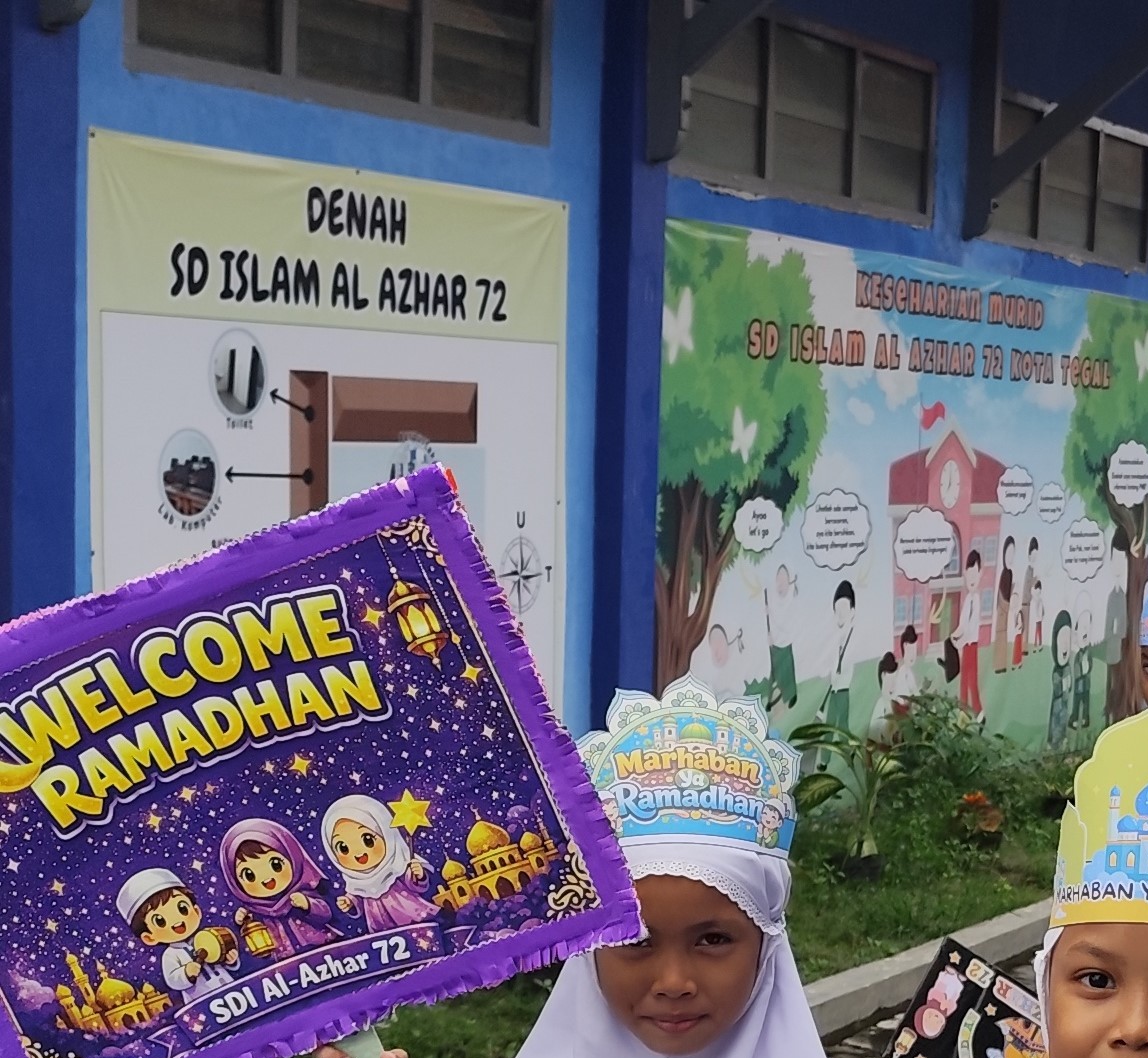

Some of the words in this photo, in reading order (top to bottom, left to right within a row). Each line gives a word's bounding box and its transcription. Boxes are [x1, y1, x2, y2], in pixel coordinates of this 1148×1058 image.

[307, 186, 406, 246] DENAH
[170, 242, 209, 297] SD
[220, 249, 320, 308] ISLAM
[331, 262, 369, 310] AL
[378, 267, 467, 320] AZHAR
[475, 278, 507, 321] 72
[747, 318, 780, 361] SD
[873, 333, 901, 370] AL
[908, 337, 976, 378] AZHAR
[982, 344, 1004, 380] 72
[1009, 348, 1054, 385] KOTA
[180, 496, 223, 532] Komputer
[516, 511, 526, 529] U
[544, 565, 552, 583] T
[0, 594, 354, 764] WELCOME
[30, 660, 383, 829] RAMADHAN
[613, 746, 762, 786] Marhaban
[679, 770, 706, 789] ya
[610, 782, 765, 823] Ramadhan
[209, 986, 259, 1025] SDI
[261, 951, 370, 1003] Al-Azhar
[372, 935, 411, 965] 72
[969, 961, 993, 985] 72
